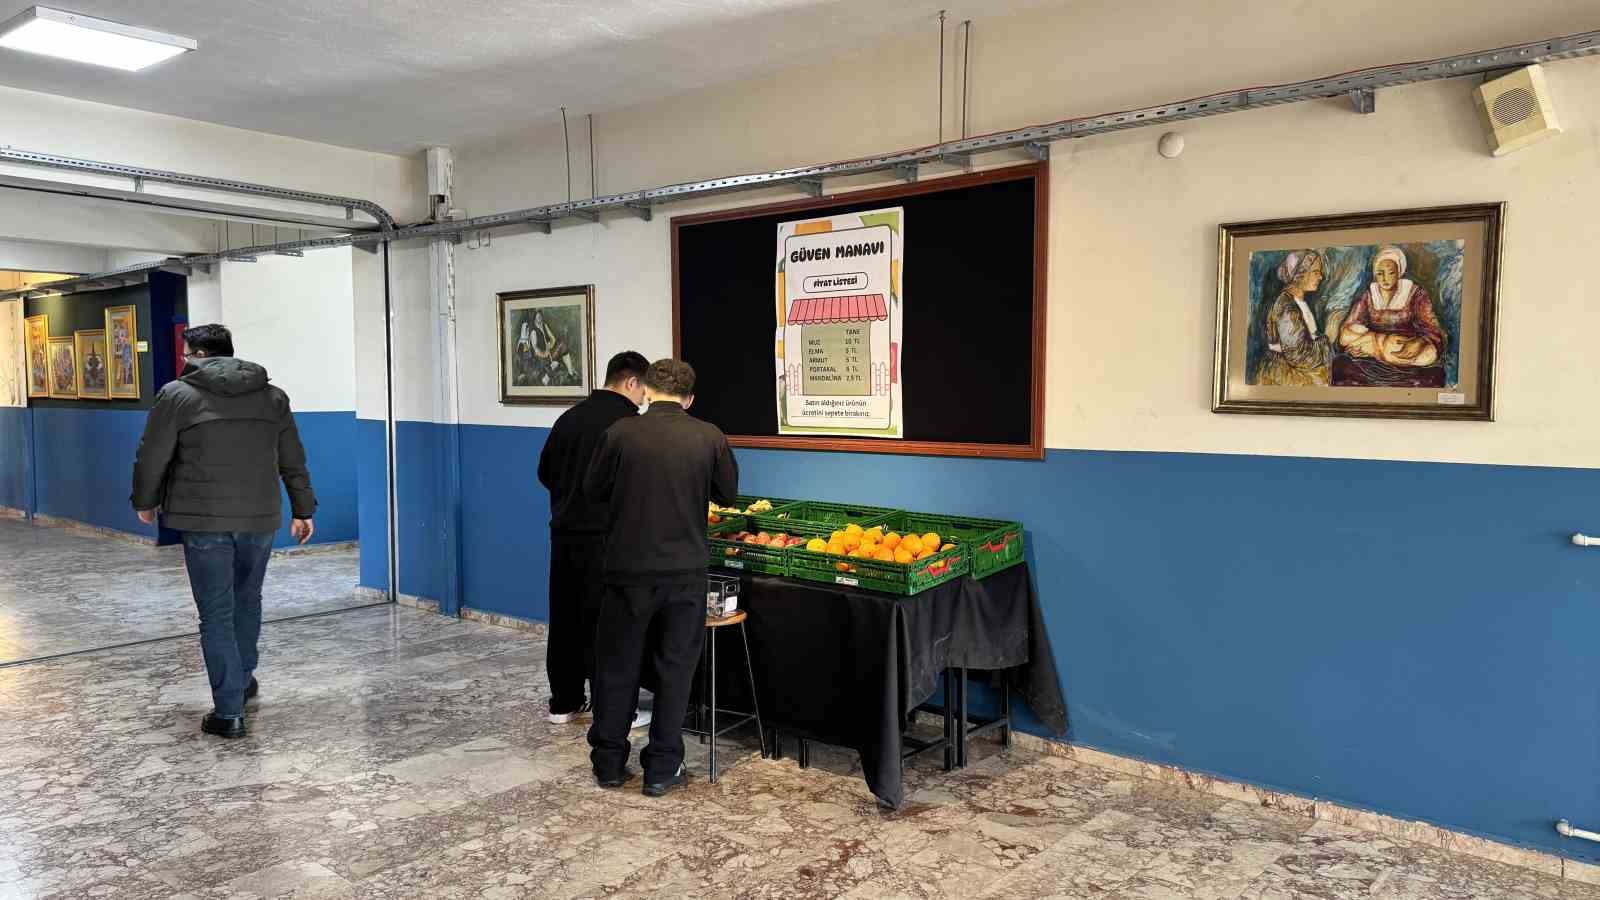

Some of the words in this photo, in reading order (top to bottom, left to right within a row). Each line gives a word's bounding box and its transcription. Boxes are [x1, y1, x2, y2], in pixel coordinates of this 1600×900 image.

[790, 247, 831, 263] GÜVEN
[835, 241, 885, 258] MANAVI
[813, 279, 832, 288] FİYAT
[833, 276, 858, 286] LİSTESİ
